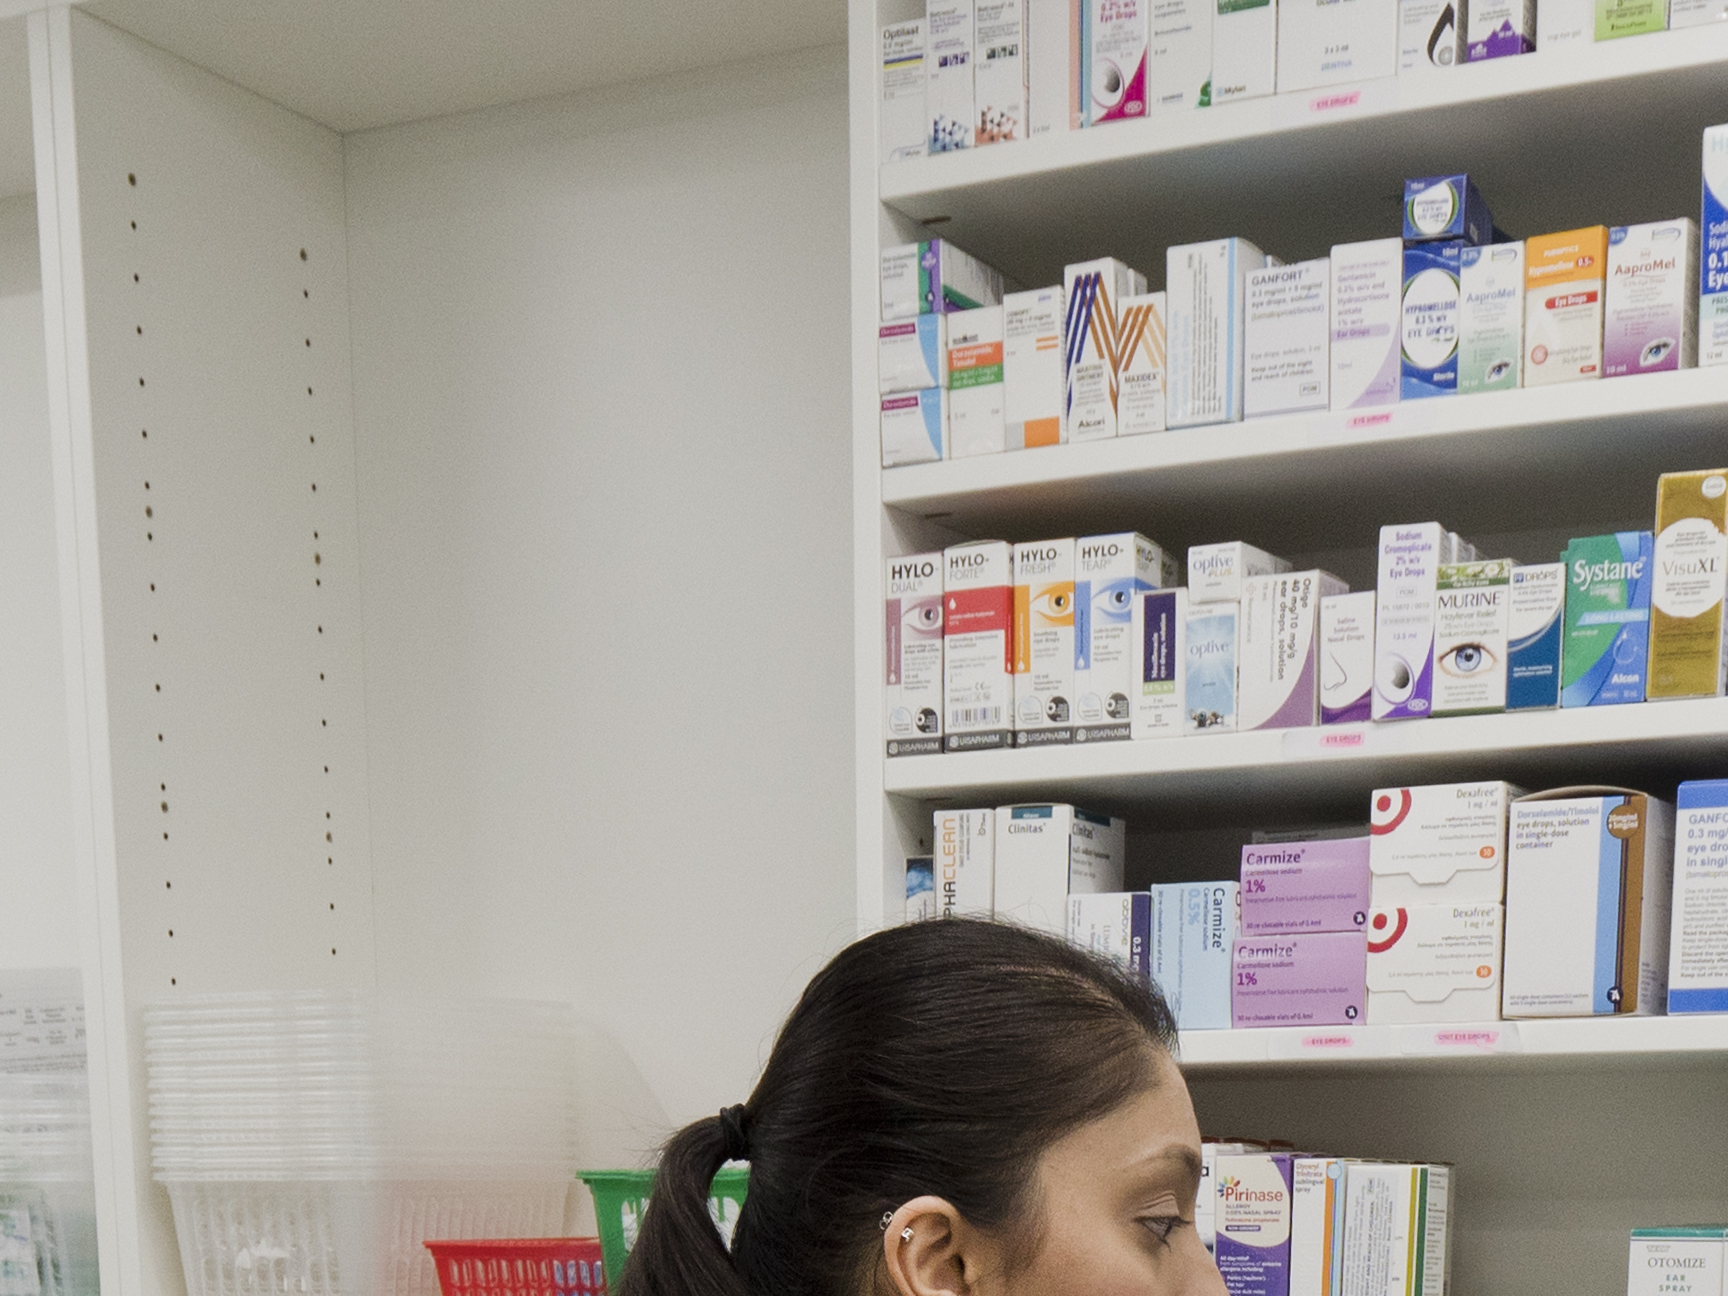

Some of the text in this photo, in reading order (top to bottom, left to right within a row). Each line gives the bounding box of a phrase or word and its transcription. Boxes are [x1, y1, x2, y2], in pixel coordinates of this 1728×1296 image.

[882, 25, 920, 41] Optilast
[1614, 257, 1676, 278] AaproMel
[1251, 270, 1304, 287] GANFORT
[1466, 288, 1516, 305] AaproMel
[1405, 300, 1457, 314] HYPROMELLOSE
[1407, 325, 1455, 339] EYE DROPS
[1124, 372, 1158, 384] MAXIDEX
[1395, 531, 1422, 542] Sodium
[1192, 554, 1233, 572] optive
[1662, 557, 1719, 576] VisuXL
[1572, 558, 1644, 591] Systane
[1438, 592, 1502, 610] MURINE
[1190, 641, 1230, 659] optive
[1612, 673, 1640, 684] Alcon
[1456, 787, 1496, 800] Dexafree
[1007, 823, 1045, 836] Clinitas
[1531, 816, 1590, 831] drops, solution
[1525, 828, 1570, 842] single-dose
[1687, 827, 1705, 840] 0.3
[1515, 839, 1554, 851] container
[1687, 844, 1705, 857] eye
[1246, 851, 1302, 867] Carmize
[1686, 856, 1697, 868] in
[1244, 878, 1267, 894] 1%
[1213, 887, 1226, 949] Carmize
[1452, 908, 1492, 920] Dexafree
[1237, 945, 1294, 961] Carmize
[1236, 972, 1258, 987] 1%
[1324, 1037, 1347, 1046] DROPS
[1226, 1186, 1284, 1203] Pirinase
[1647, 1257, 1707, 1269] OTOMIZE
[1658, 1285, 1693, 1293] SPRAY
